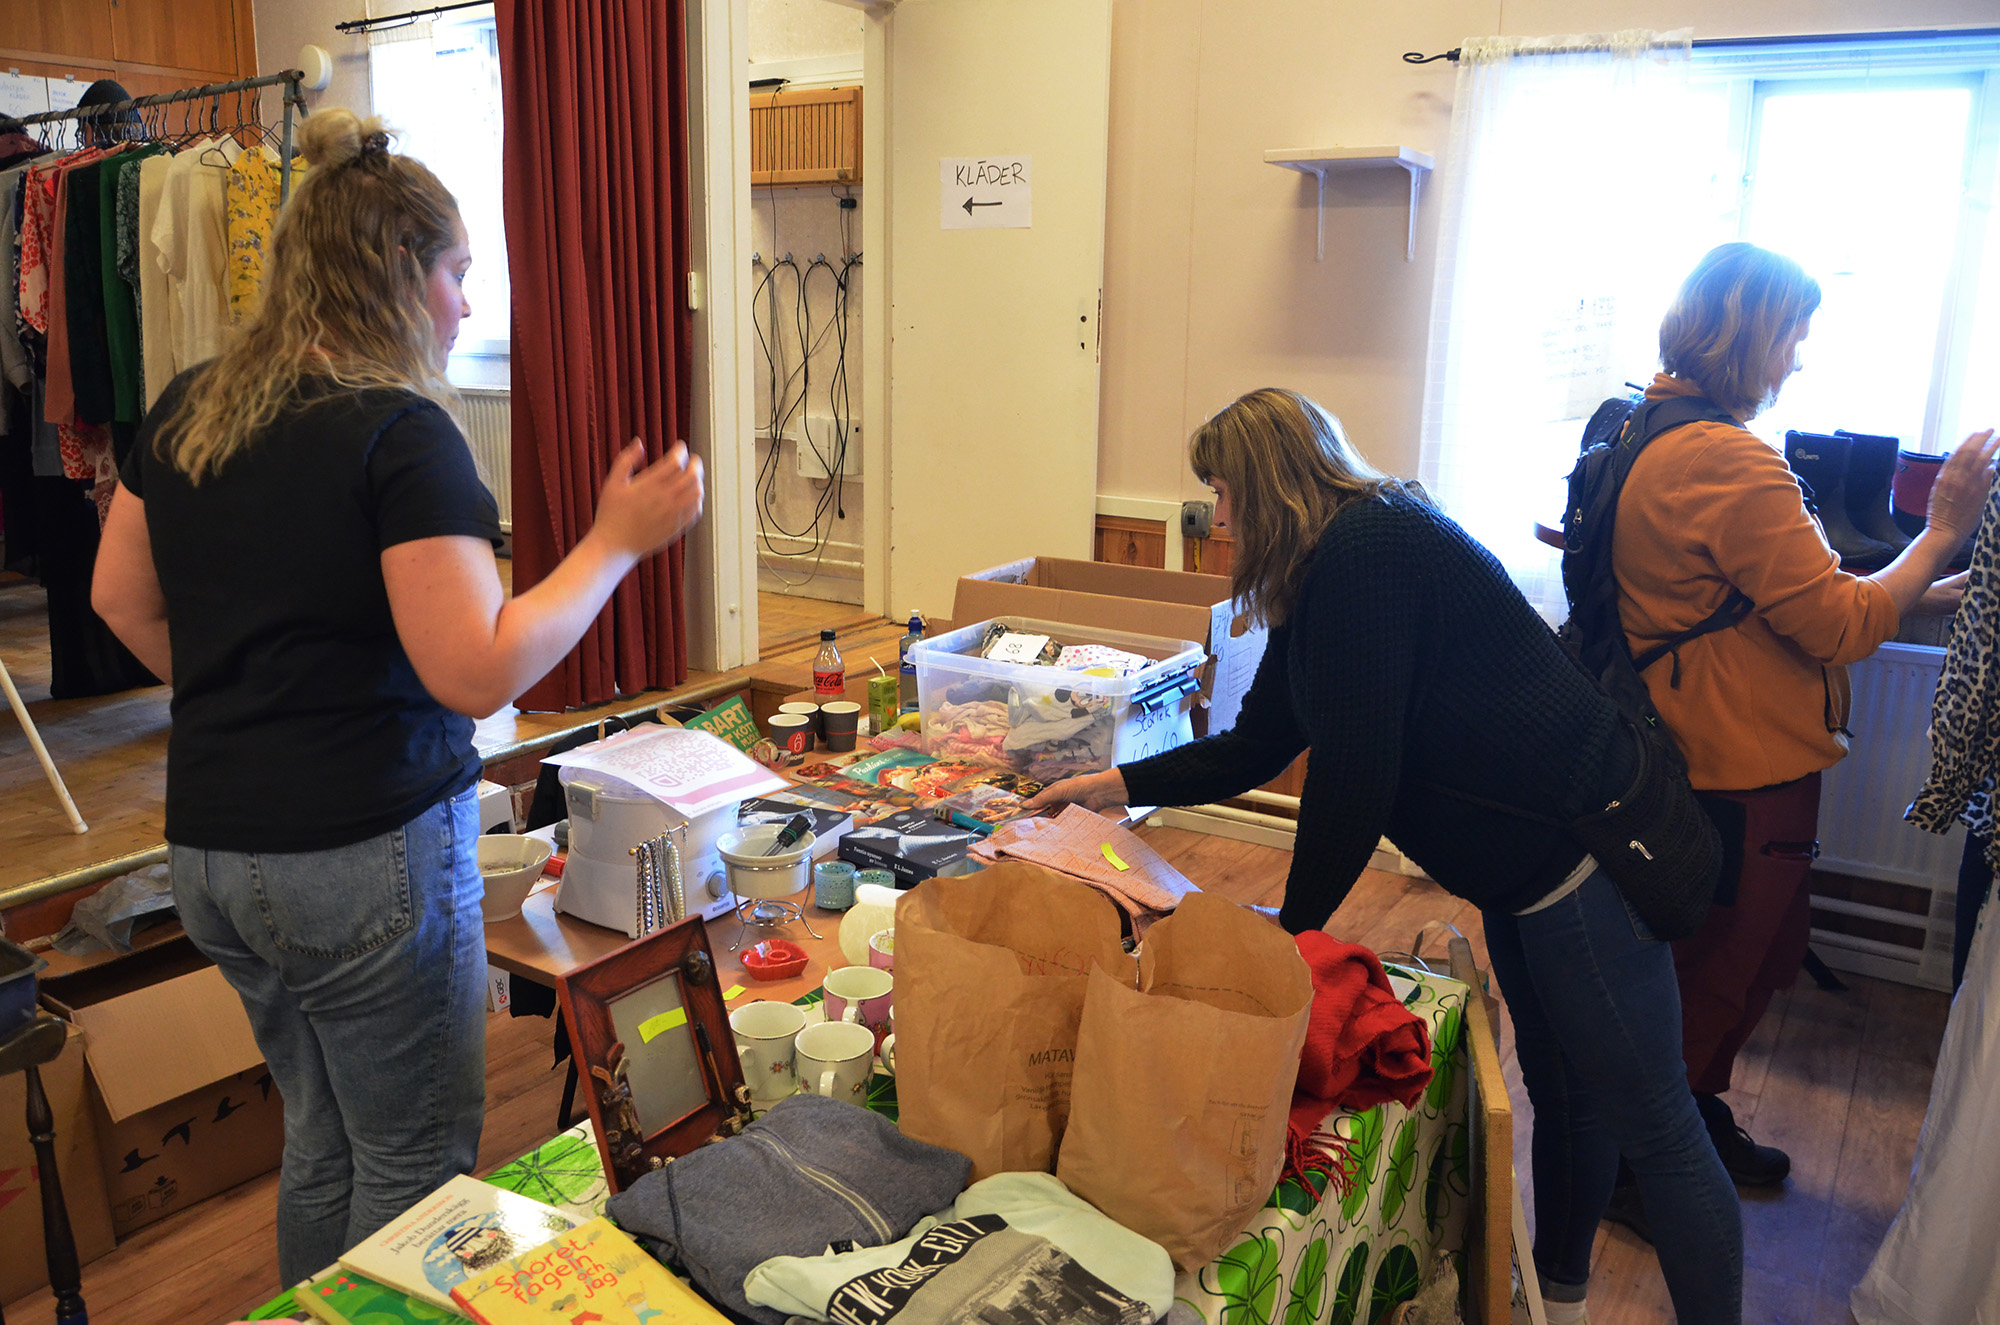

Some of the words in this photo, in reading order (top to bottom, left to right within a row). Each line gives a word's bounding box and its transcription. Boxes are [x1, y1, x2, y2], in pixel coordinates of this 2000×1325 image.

[693, 702, 748, 737] BART
[732, 720, 756, 740] KÖTT
[445, 1209, 468, 1225] mera
[389, 1234, 417, 1256] Jakob
[576, 1262, 605, 1282] och
[583, 1272, 618, 1299] jag
